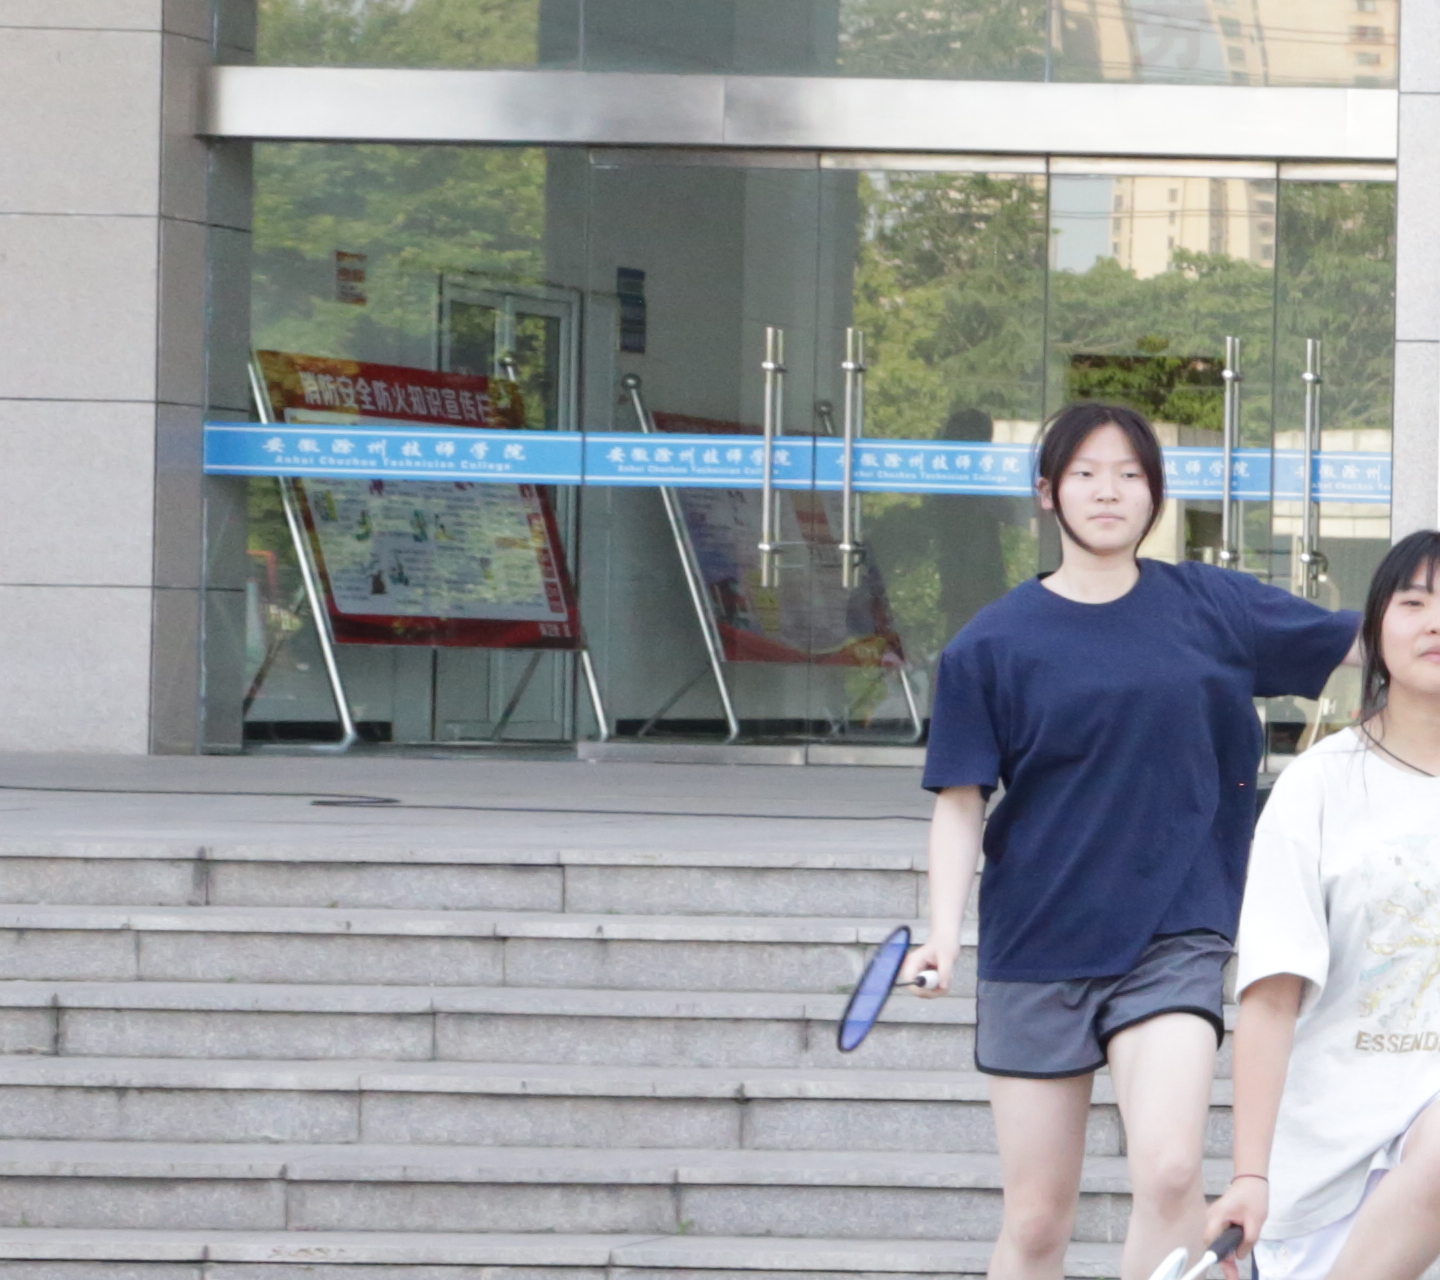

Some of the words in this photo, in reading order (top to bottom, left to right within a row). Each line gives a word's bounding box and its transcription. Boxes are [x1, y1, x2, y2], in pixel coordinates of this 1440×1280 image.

[262, 436, 526, 461] 安徽滁州技师学院
